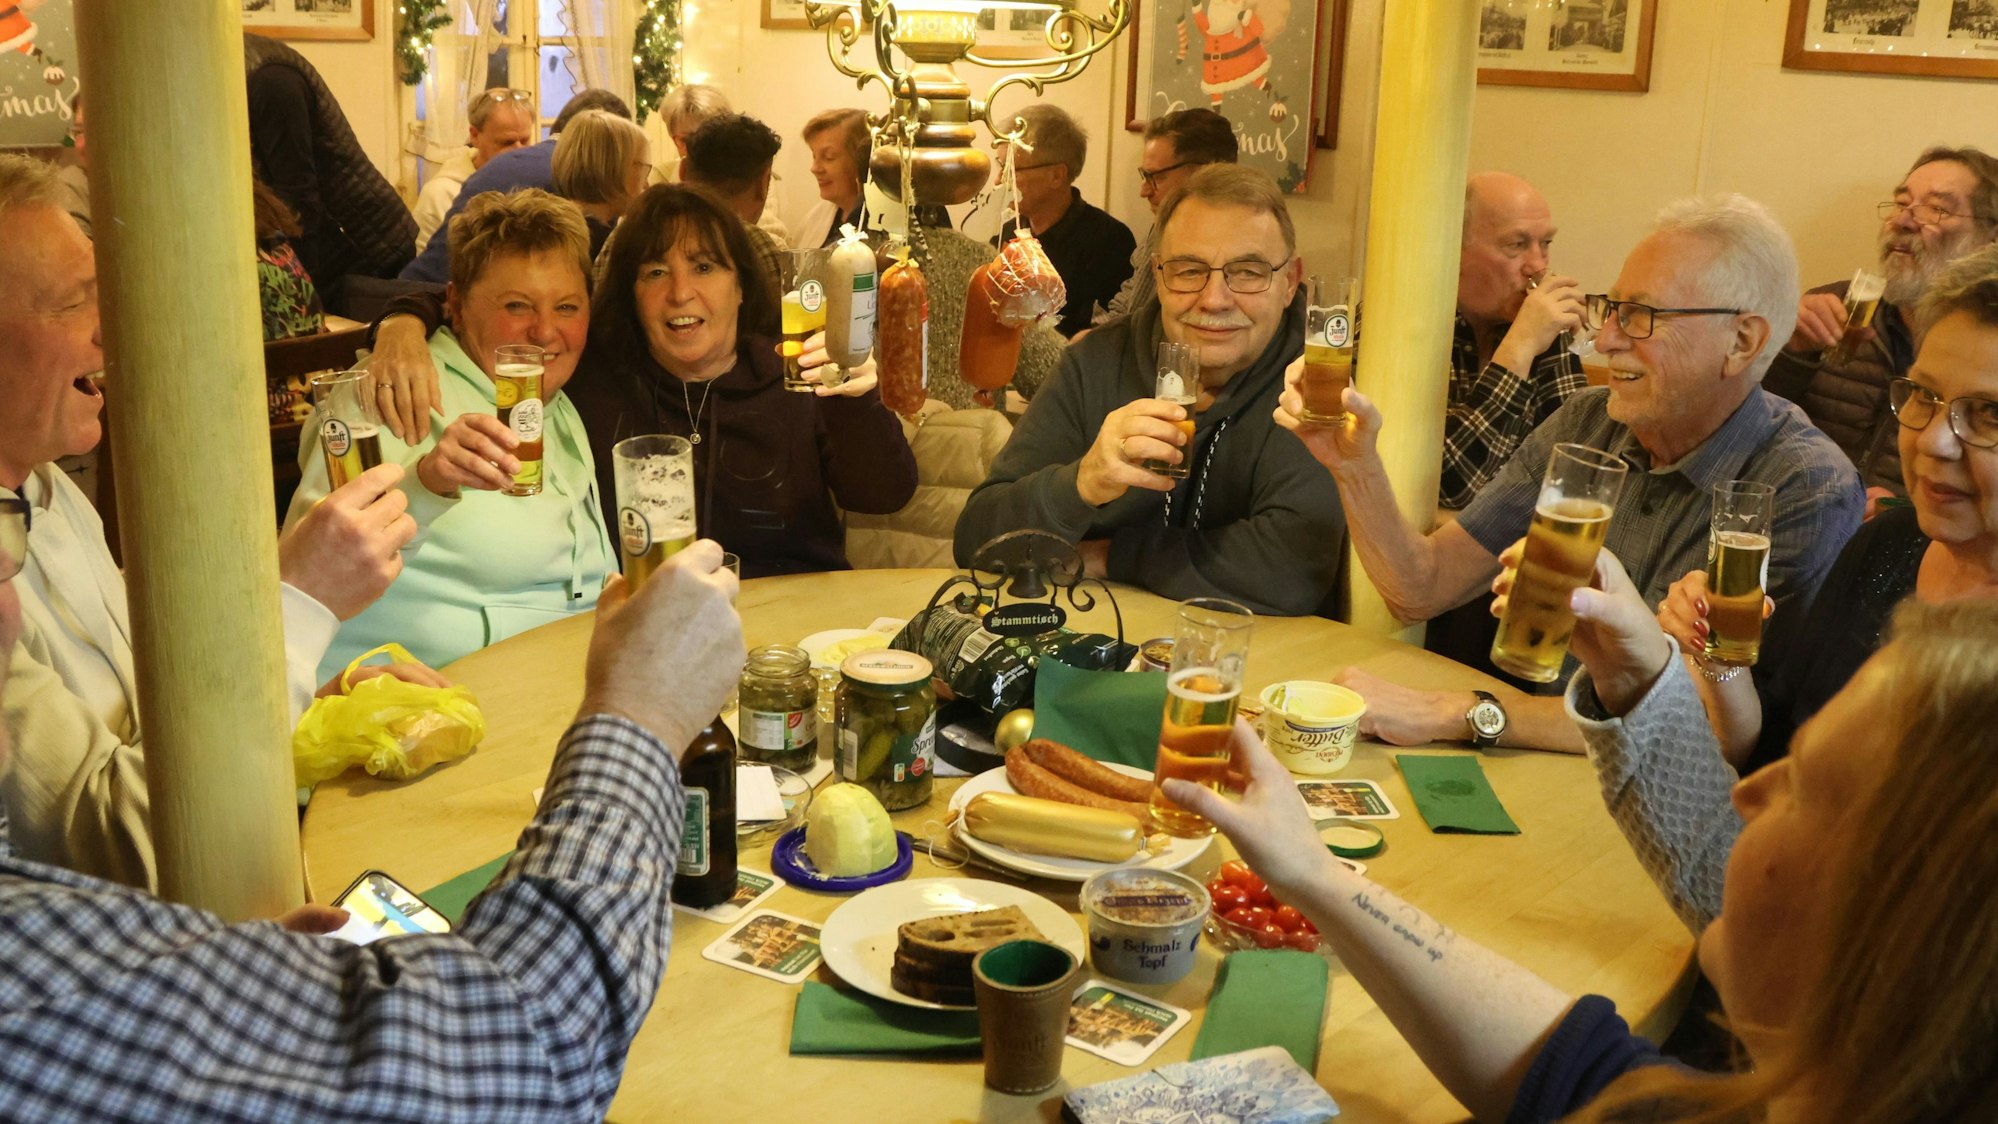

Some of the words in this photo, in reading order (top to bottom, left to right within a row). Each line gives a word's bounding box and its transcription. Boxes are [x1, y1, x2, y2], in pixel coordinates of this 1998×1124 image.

[0, 76, 79, 120] mas
[1238, 114, 1299, 162] mas
[990, 613, 1059, 628] Stammtisch
[1290, 729, 1345, 747] Butter
[1123, 939, 1181, 954] Schmalz
[1138, 955, 1168, 970] Topf
